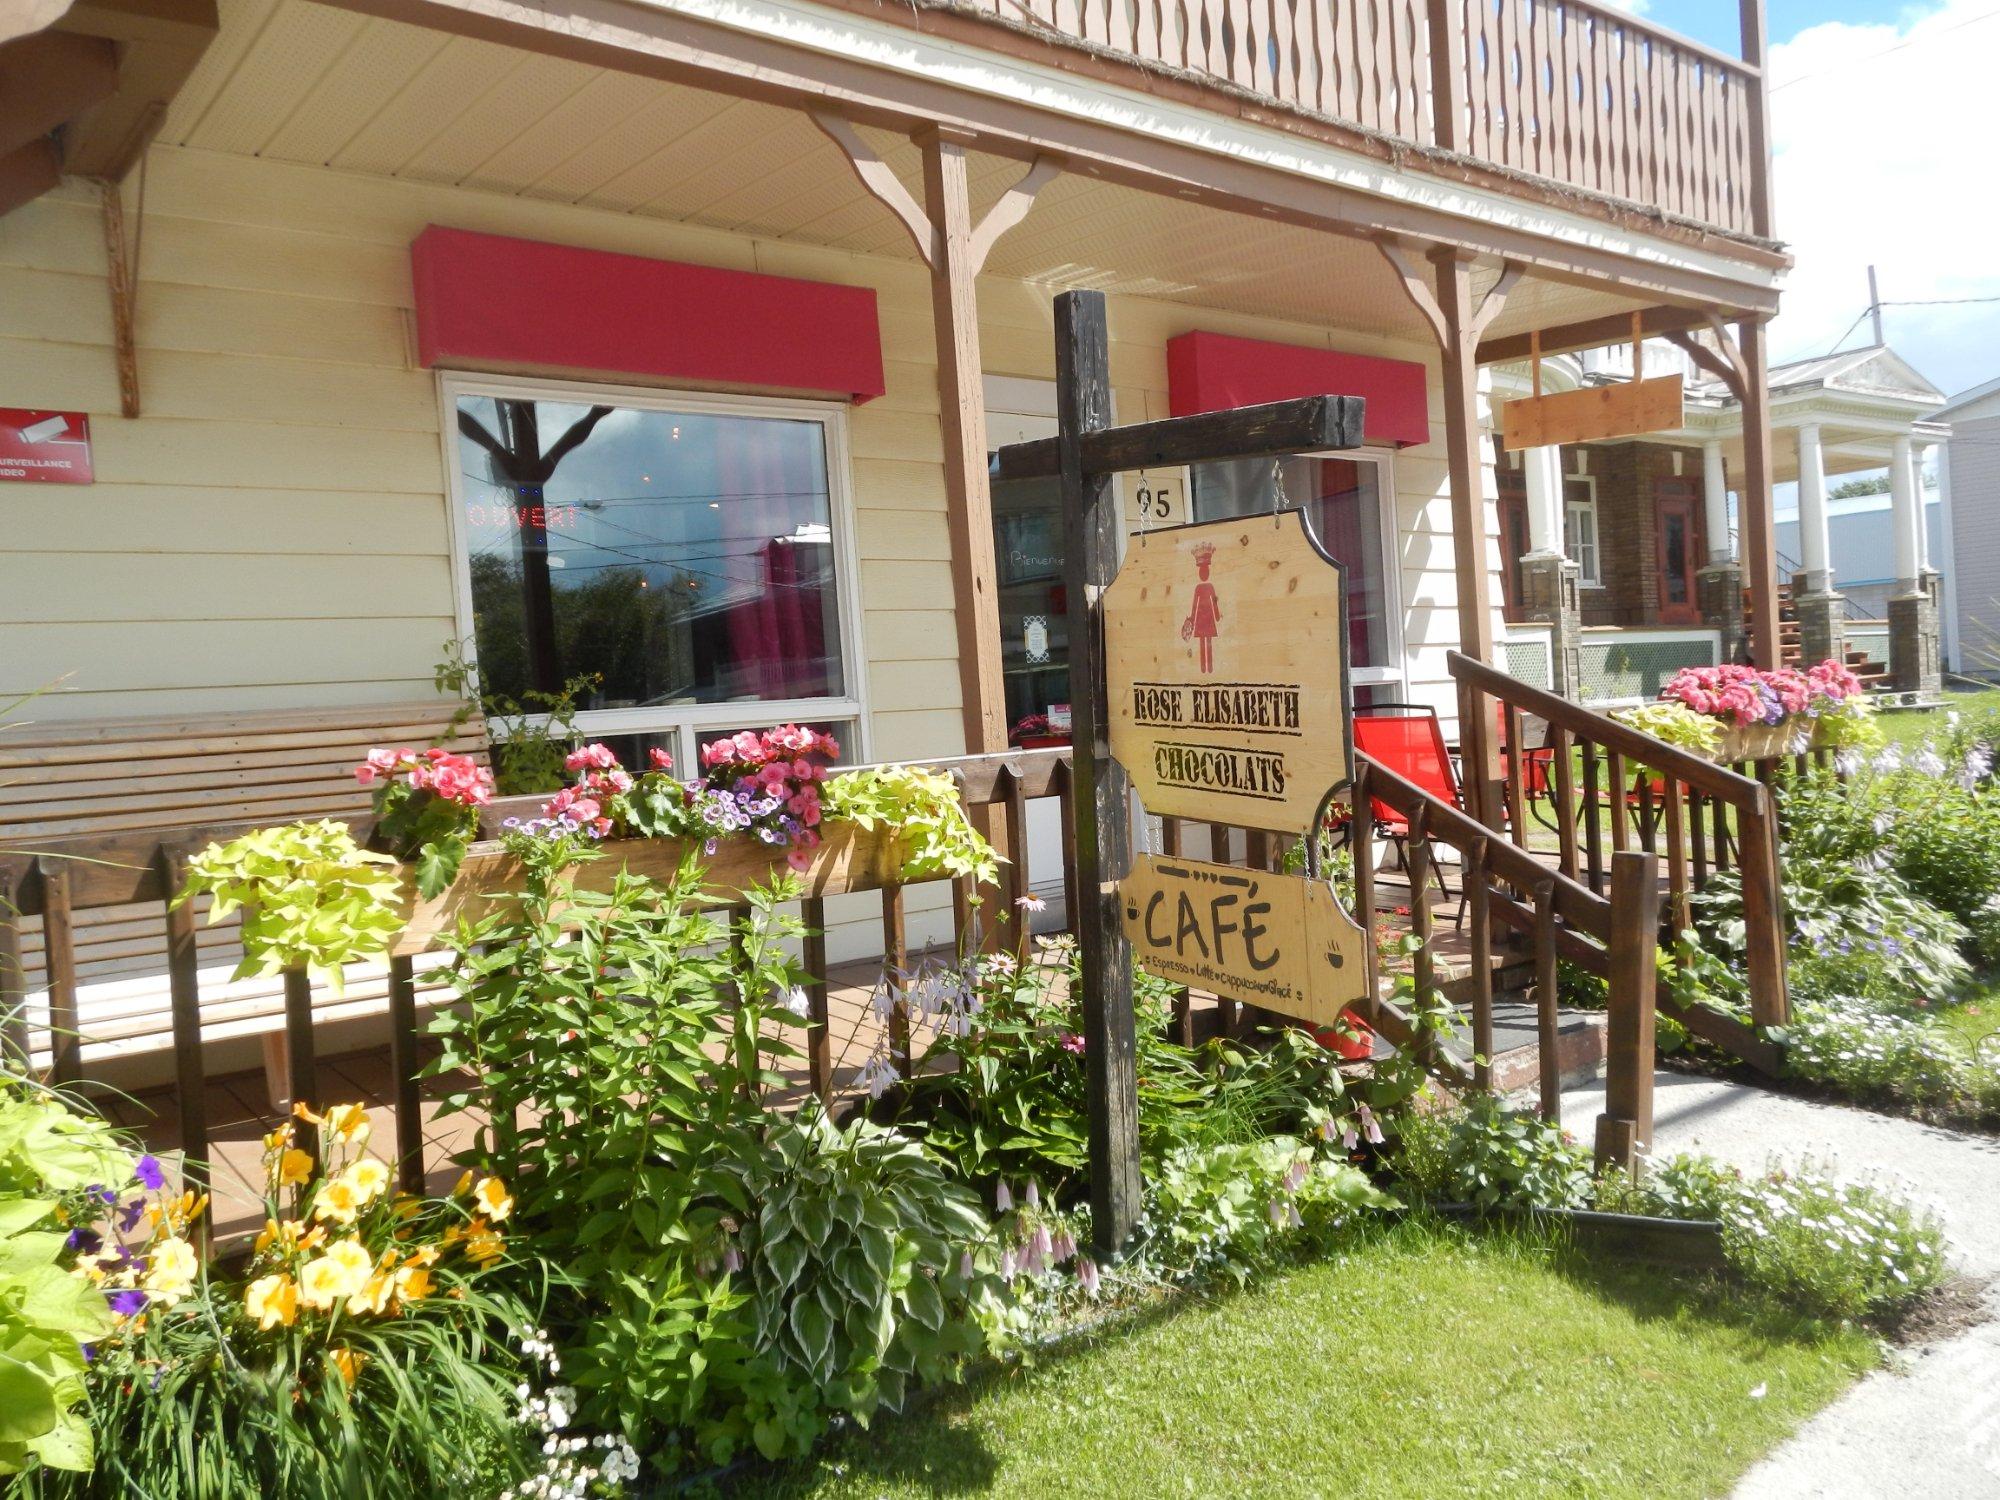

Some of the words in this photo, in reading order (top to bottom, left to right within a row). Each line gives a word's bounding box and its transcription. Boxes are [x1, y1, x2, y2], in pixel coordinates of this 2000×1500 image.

[0, 458, 73, 469] URVEILLANCE
[0, 468, 26, 477] IDEO
[468, 504, 577, 528] OUVERT
[1136, 488, 1170, 518] 95
[1133, 687, 1183, 722] ROSE
[1191, 688, 1300, 729] ELISABETH
[1154, 746, 1285, 794] CHOCOLATS
[1145, 881, 1280, 971] CAFÉ
